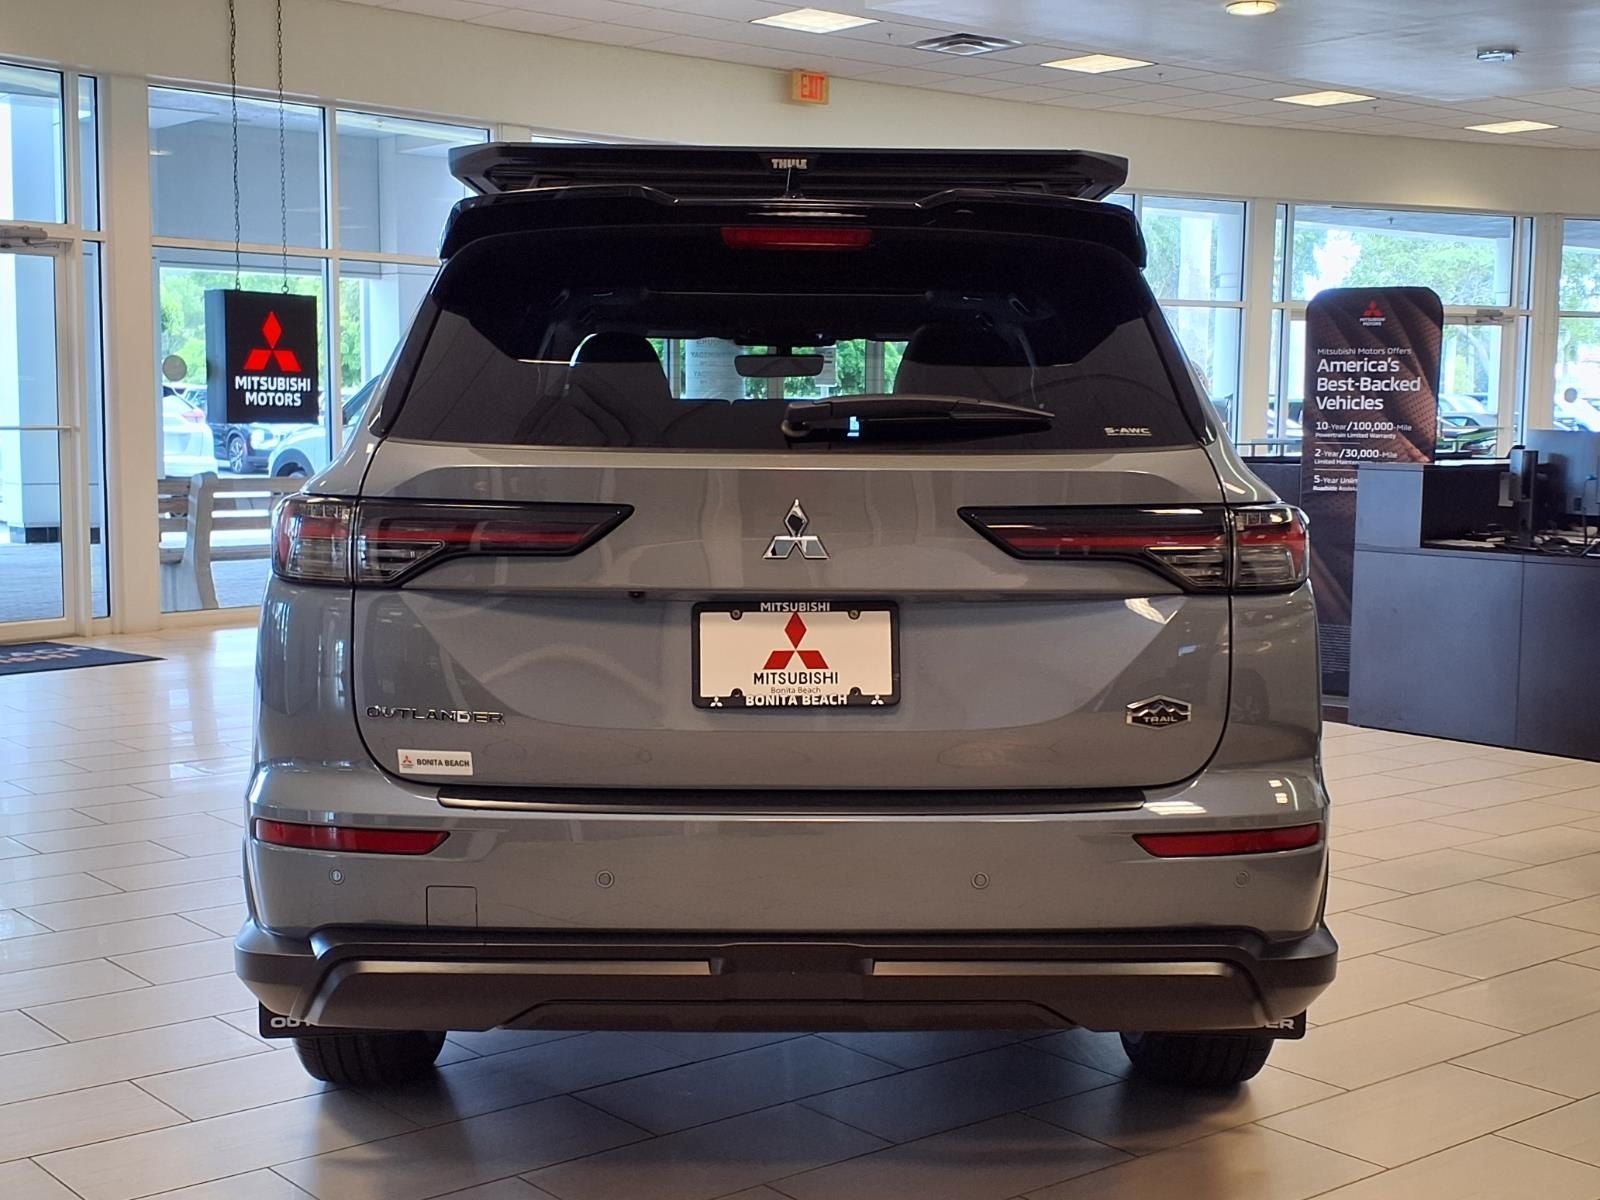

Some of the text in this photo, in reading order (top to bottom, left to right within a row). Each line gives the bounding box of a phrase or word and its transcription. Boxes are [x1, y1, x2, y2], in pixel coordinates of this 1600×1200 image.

[800, 74, 825, 101] EXIT
[771, 158, 808, 170] THULE
[1387, 347, 1412, 355] Offers
[1316, 358, 1400, 373] America's
[234, 375, 311, 392] MITSUBISHI
[1316, 377, 1421, 392] Best-Backed
[245, 391, 302, 407] MOTORS
[1316, 395, 1384, 410] Vehicles
[1313, 474, 1339, 484] 5-Year
[760, 602, 831, 612] MITSUBISHI
[753, 672, 839, 685] MITSUBISHI
[770, 686, 822, 694] Bonita Beach
[745, 694, 848, 707] BONITA BEACH
[366, 704, 506, 725] OUTLANDER
[416, 758, 443, 767] BONITA
[444, 760, 470, 768] BEACH
